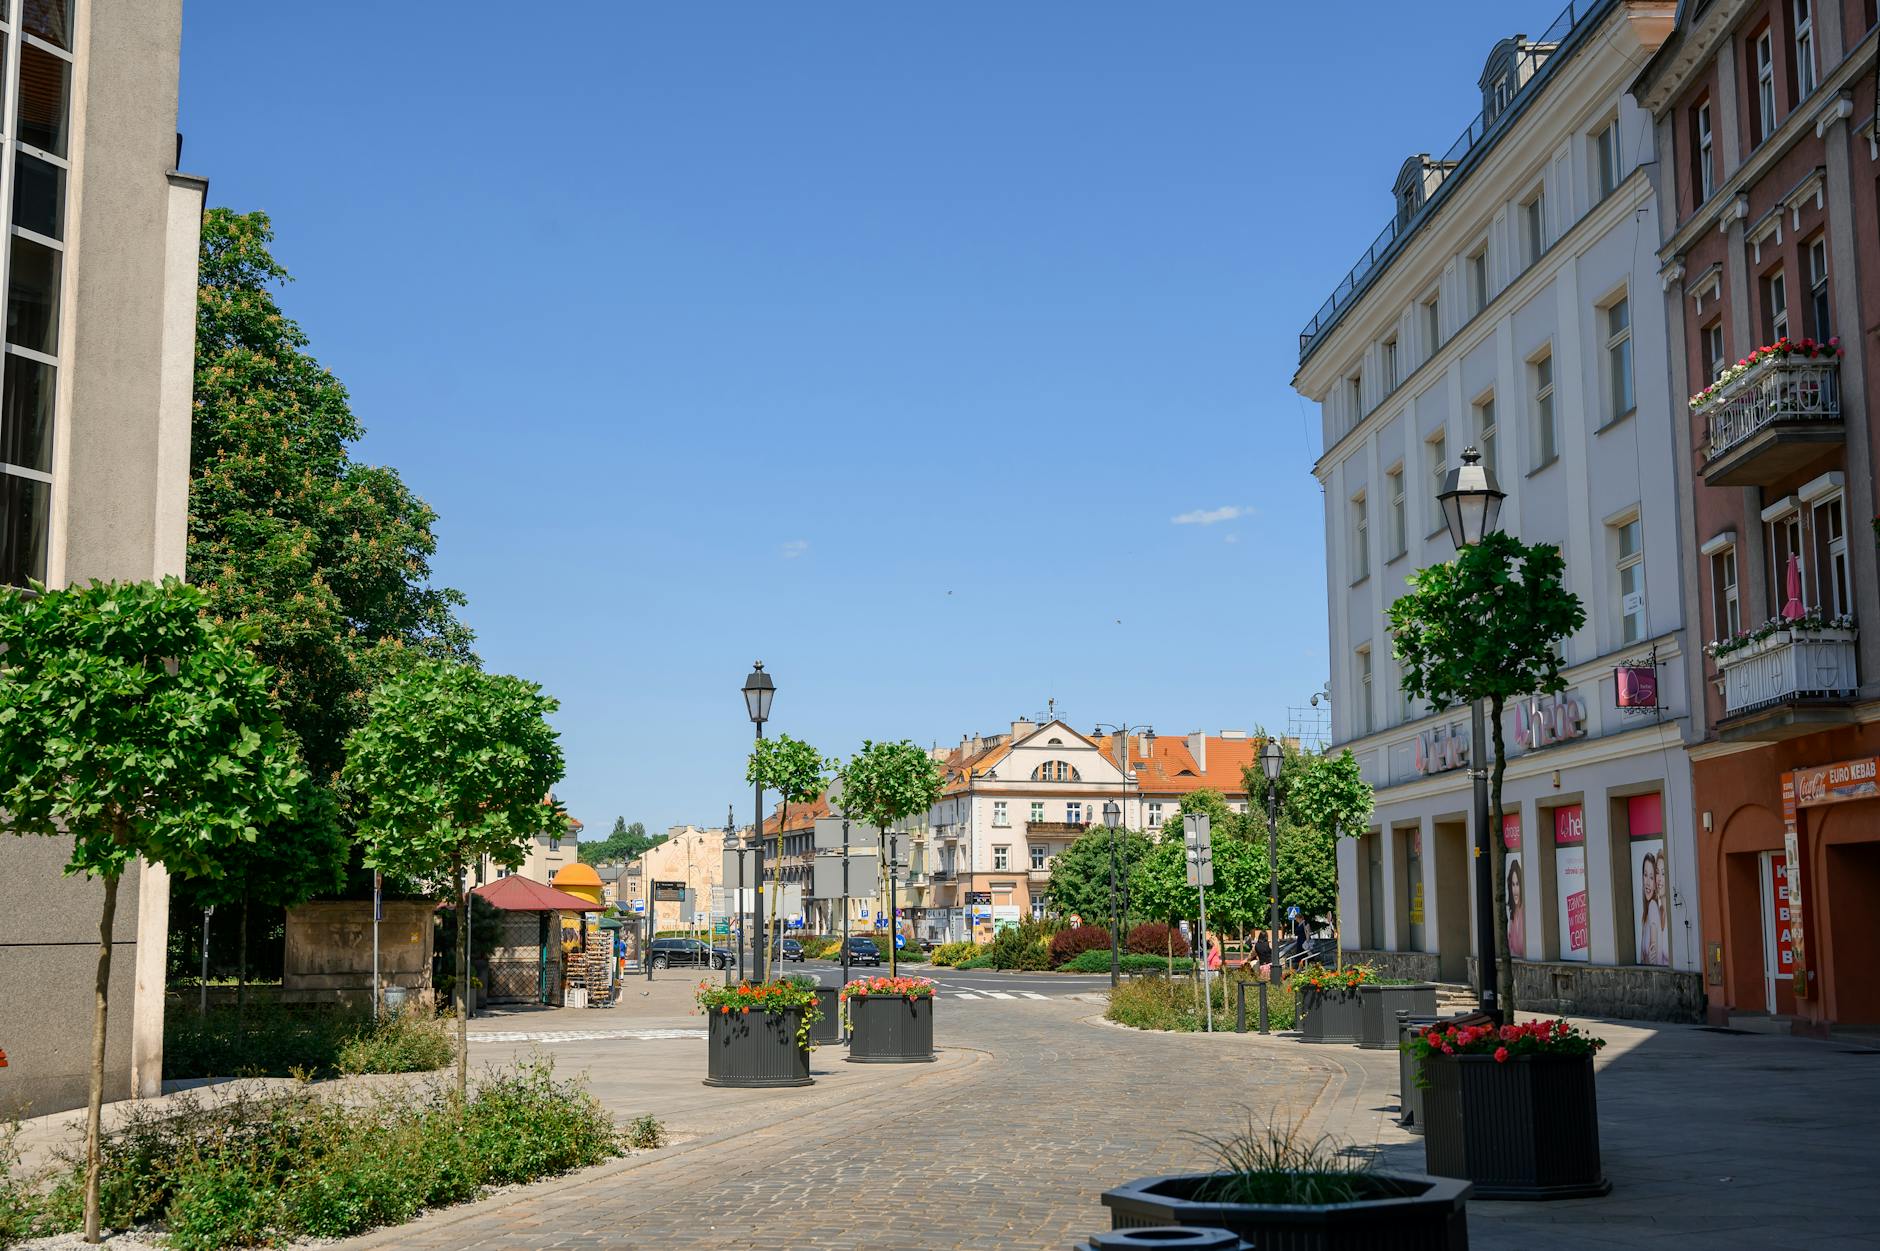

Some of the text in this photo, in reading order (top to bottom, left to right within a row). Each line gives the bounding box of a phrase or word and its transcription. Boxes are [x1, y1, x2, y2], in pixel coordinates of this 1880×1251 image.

[1529, 690, 1587, 748] hebe
[1829, 762, 1876, 784] EURO KEBAB
[1776, 864, 1793, 964] KEBAB
